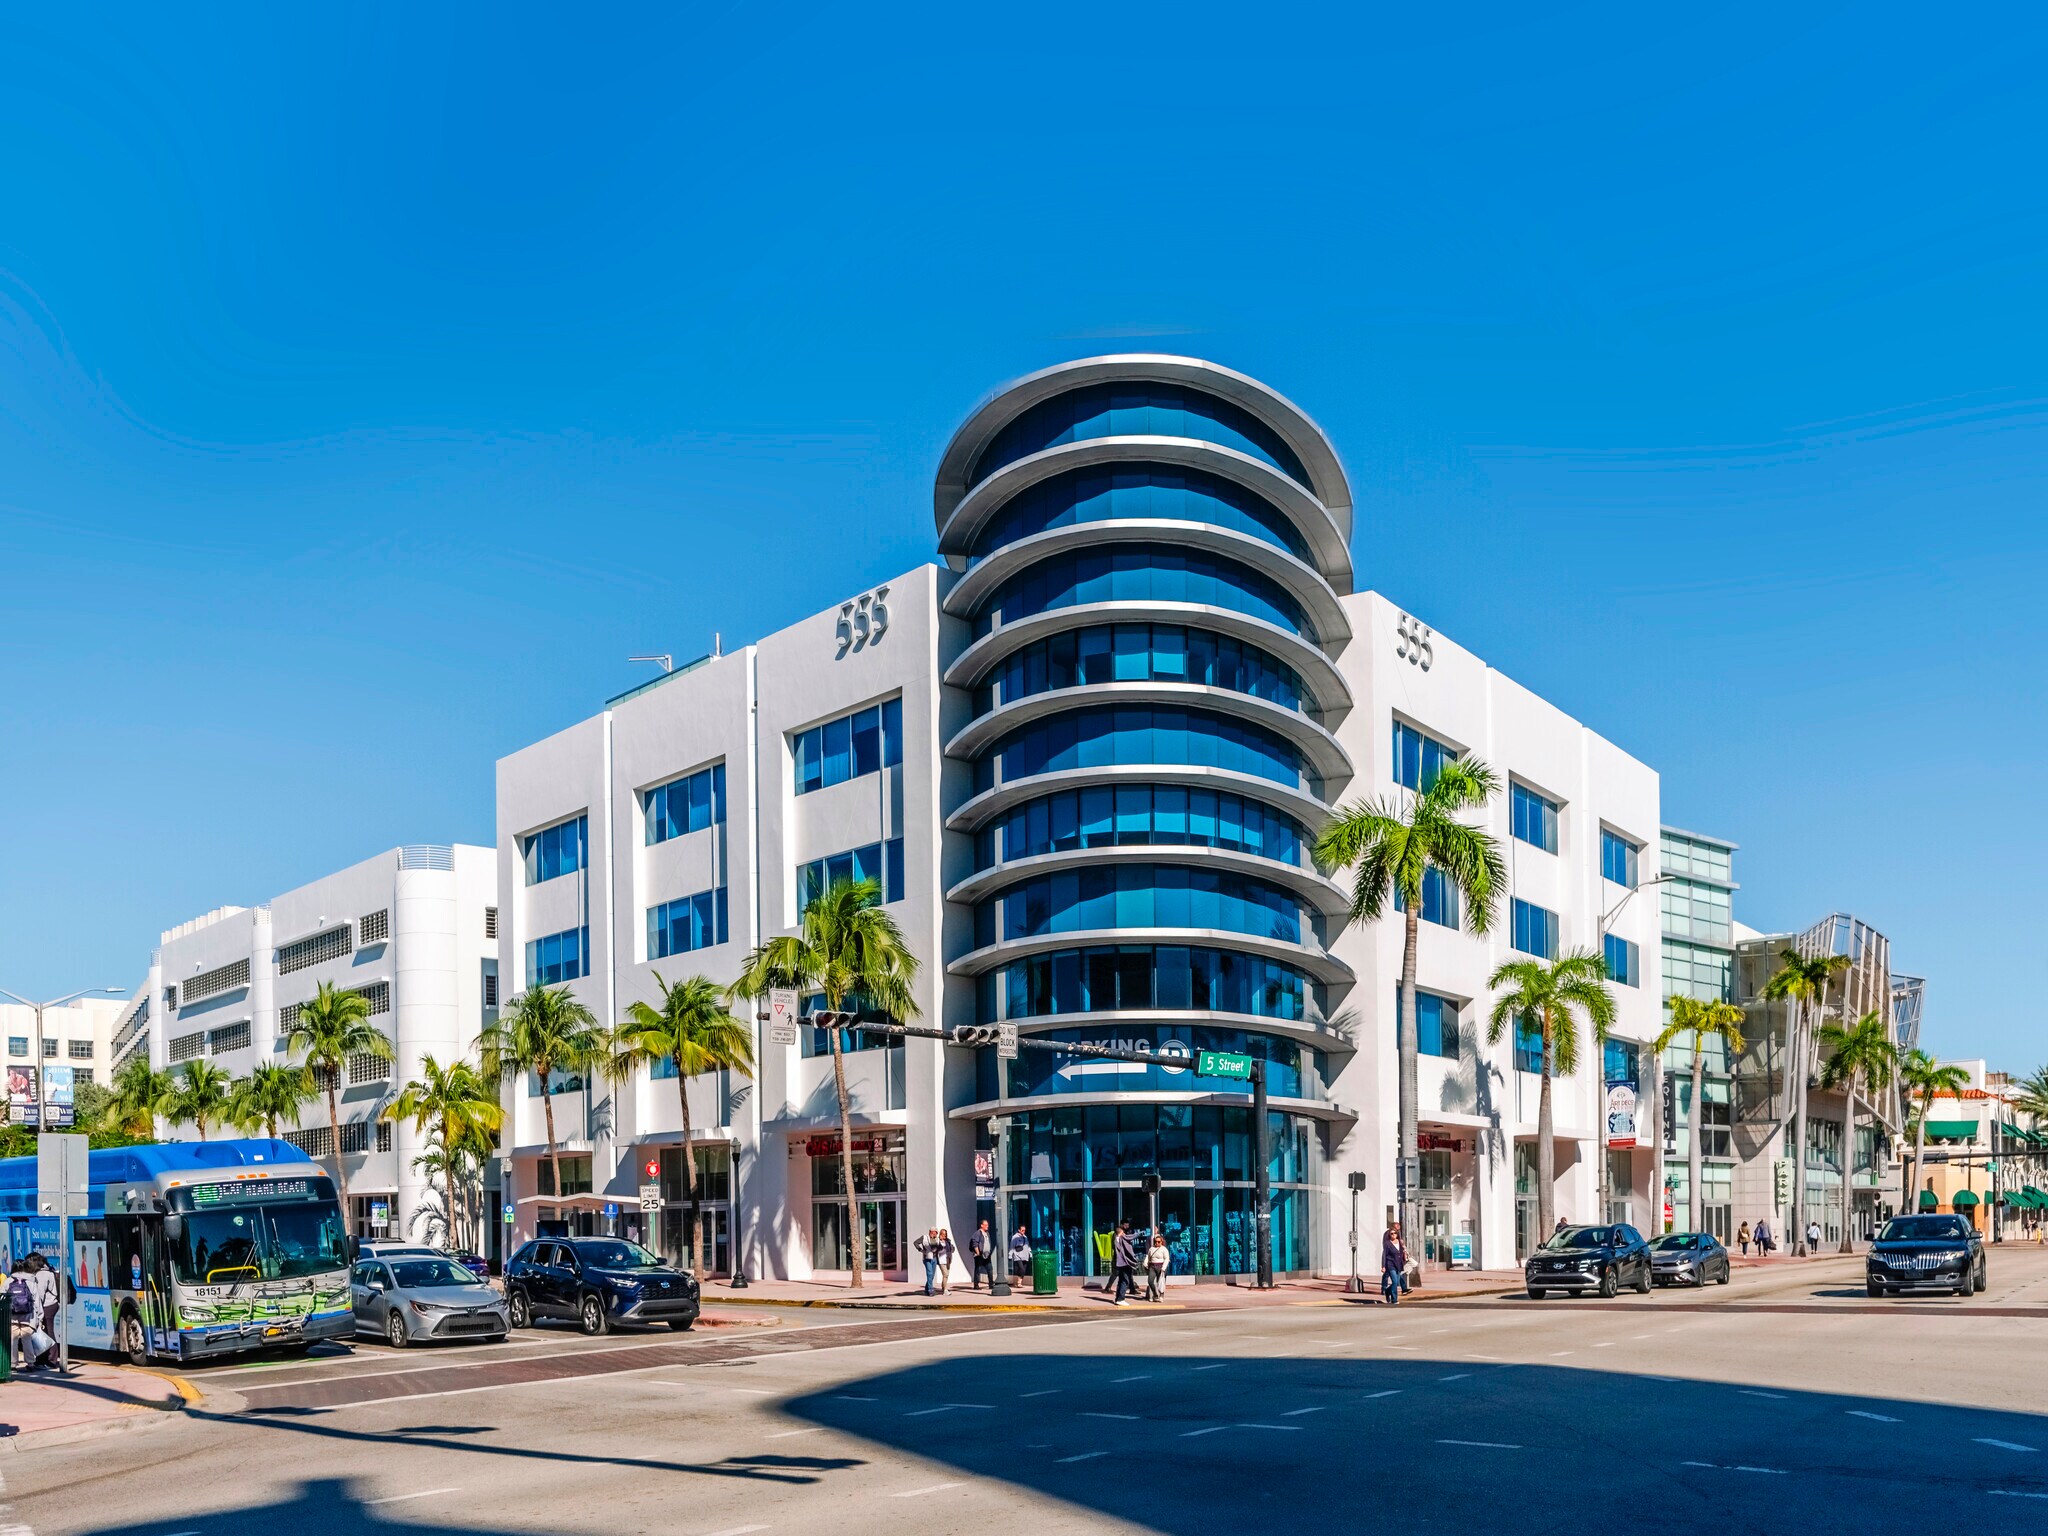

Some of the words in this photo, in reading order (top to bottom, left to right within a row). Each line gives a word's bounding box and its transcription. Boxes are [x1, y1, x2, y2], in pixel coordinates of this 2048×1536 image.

[836, 585, 890, 648] 555
[1397, 610, 1433, 669] 555
[1007, 1027, 1016, 1036] NOT
[1000, 1038, 1016, 1047] BLOCK
[1057, 1039, 1150, 1058] KING
[1206, 1056, 1214, 1071] 5
[1218, 1058, 1244, 1072] Street
[873, 1138, 883, 1148] 24
[642, 1199, 659, 1209] 25
[194, 1287, 221, 1297] 18151
[84, 1299, 104, 1313] Florida
[86, 1315, 97, 1328] Blue
